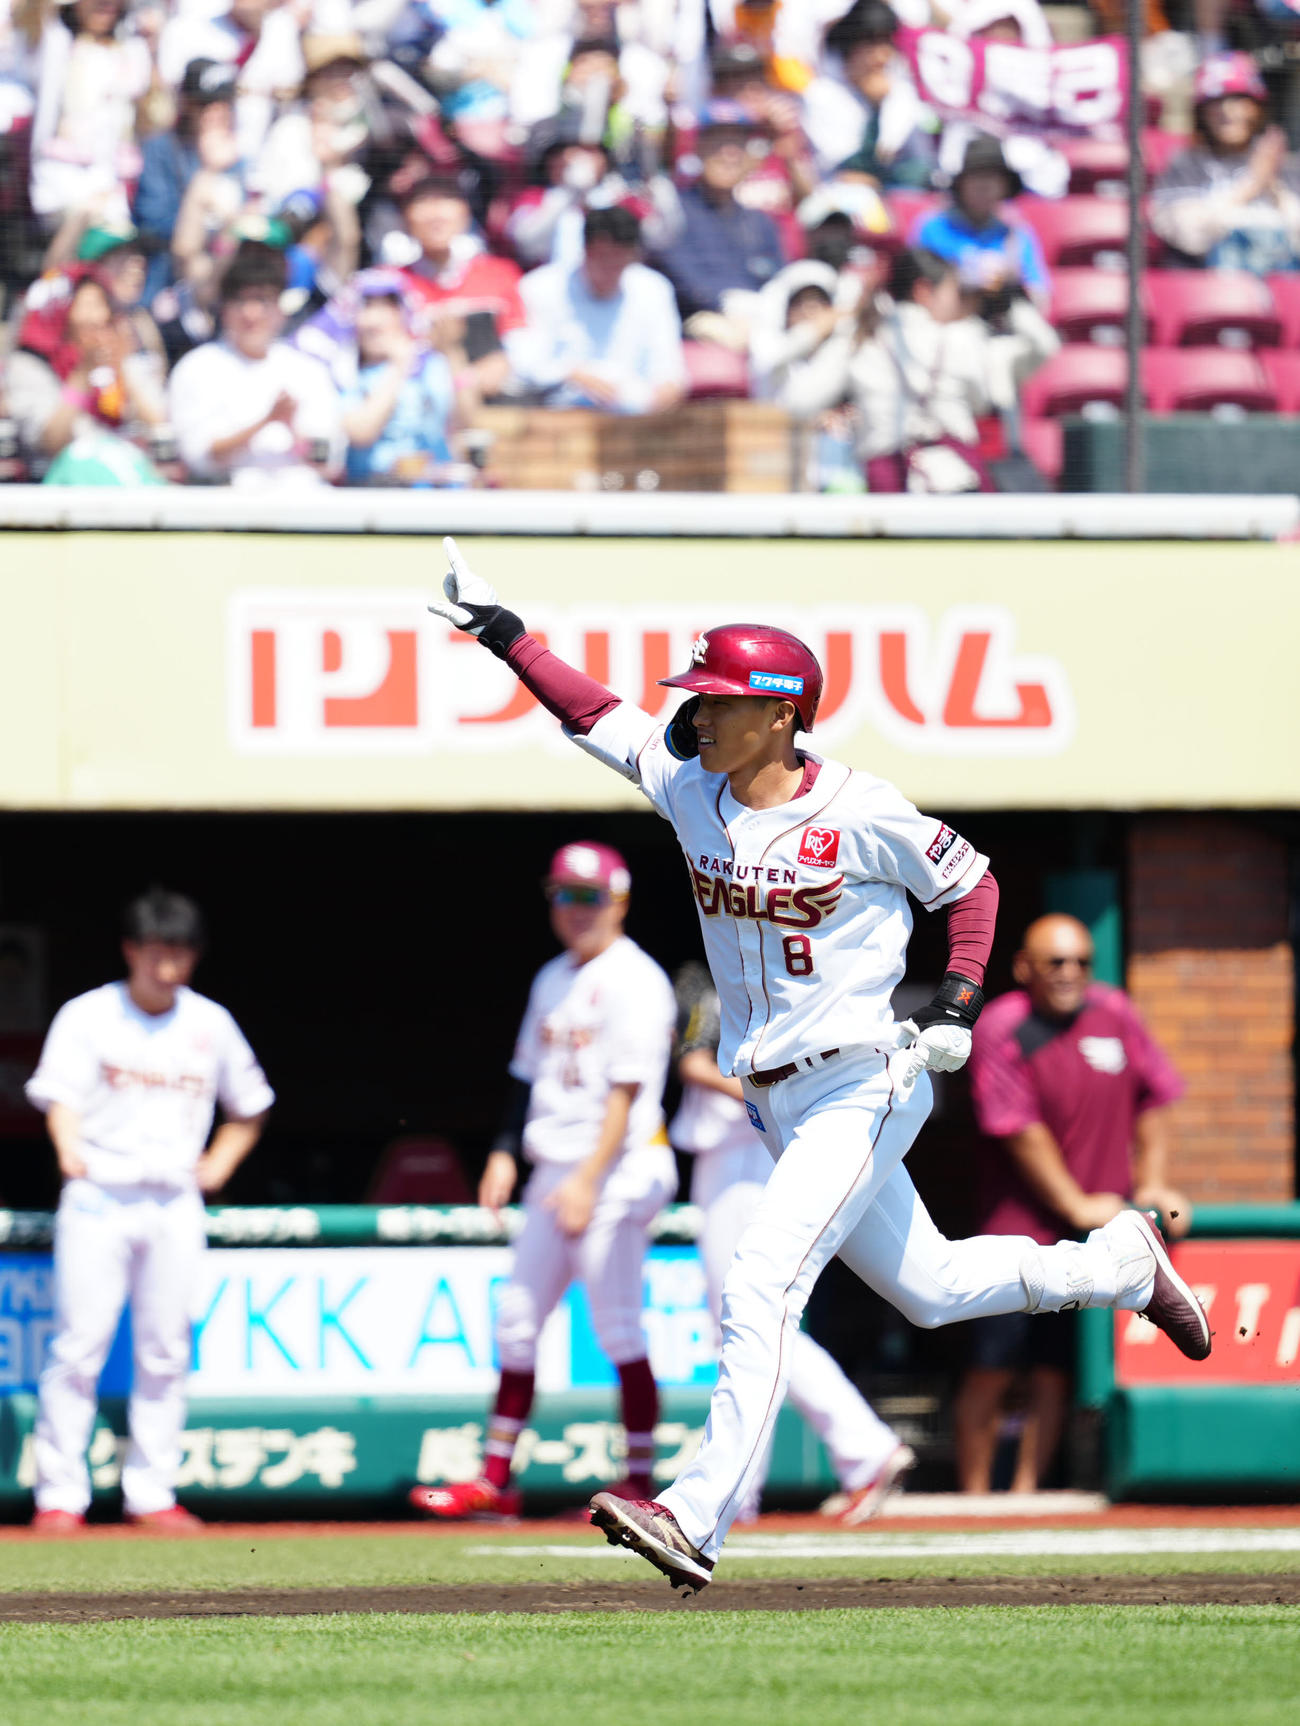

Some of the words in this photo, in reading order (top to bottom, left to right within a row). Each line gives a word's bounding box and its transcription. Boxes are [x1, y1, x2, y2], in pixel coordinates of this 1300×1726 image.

[699, 853, 798, 885] RAKUTEN
[697, 873, 845, 929] EAGLES
[782, 933, 814, 977] 8
